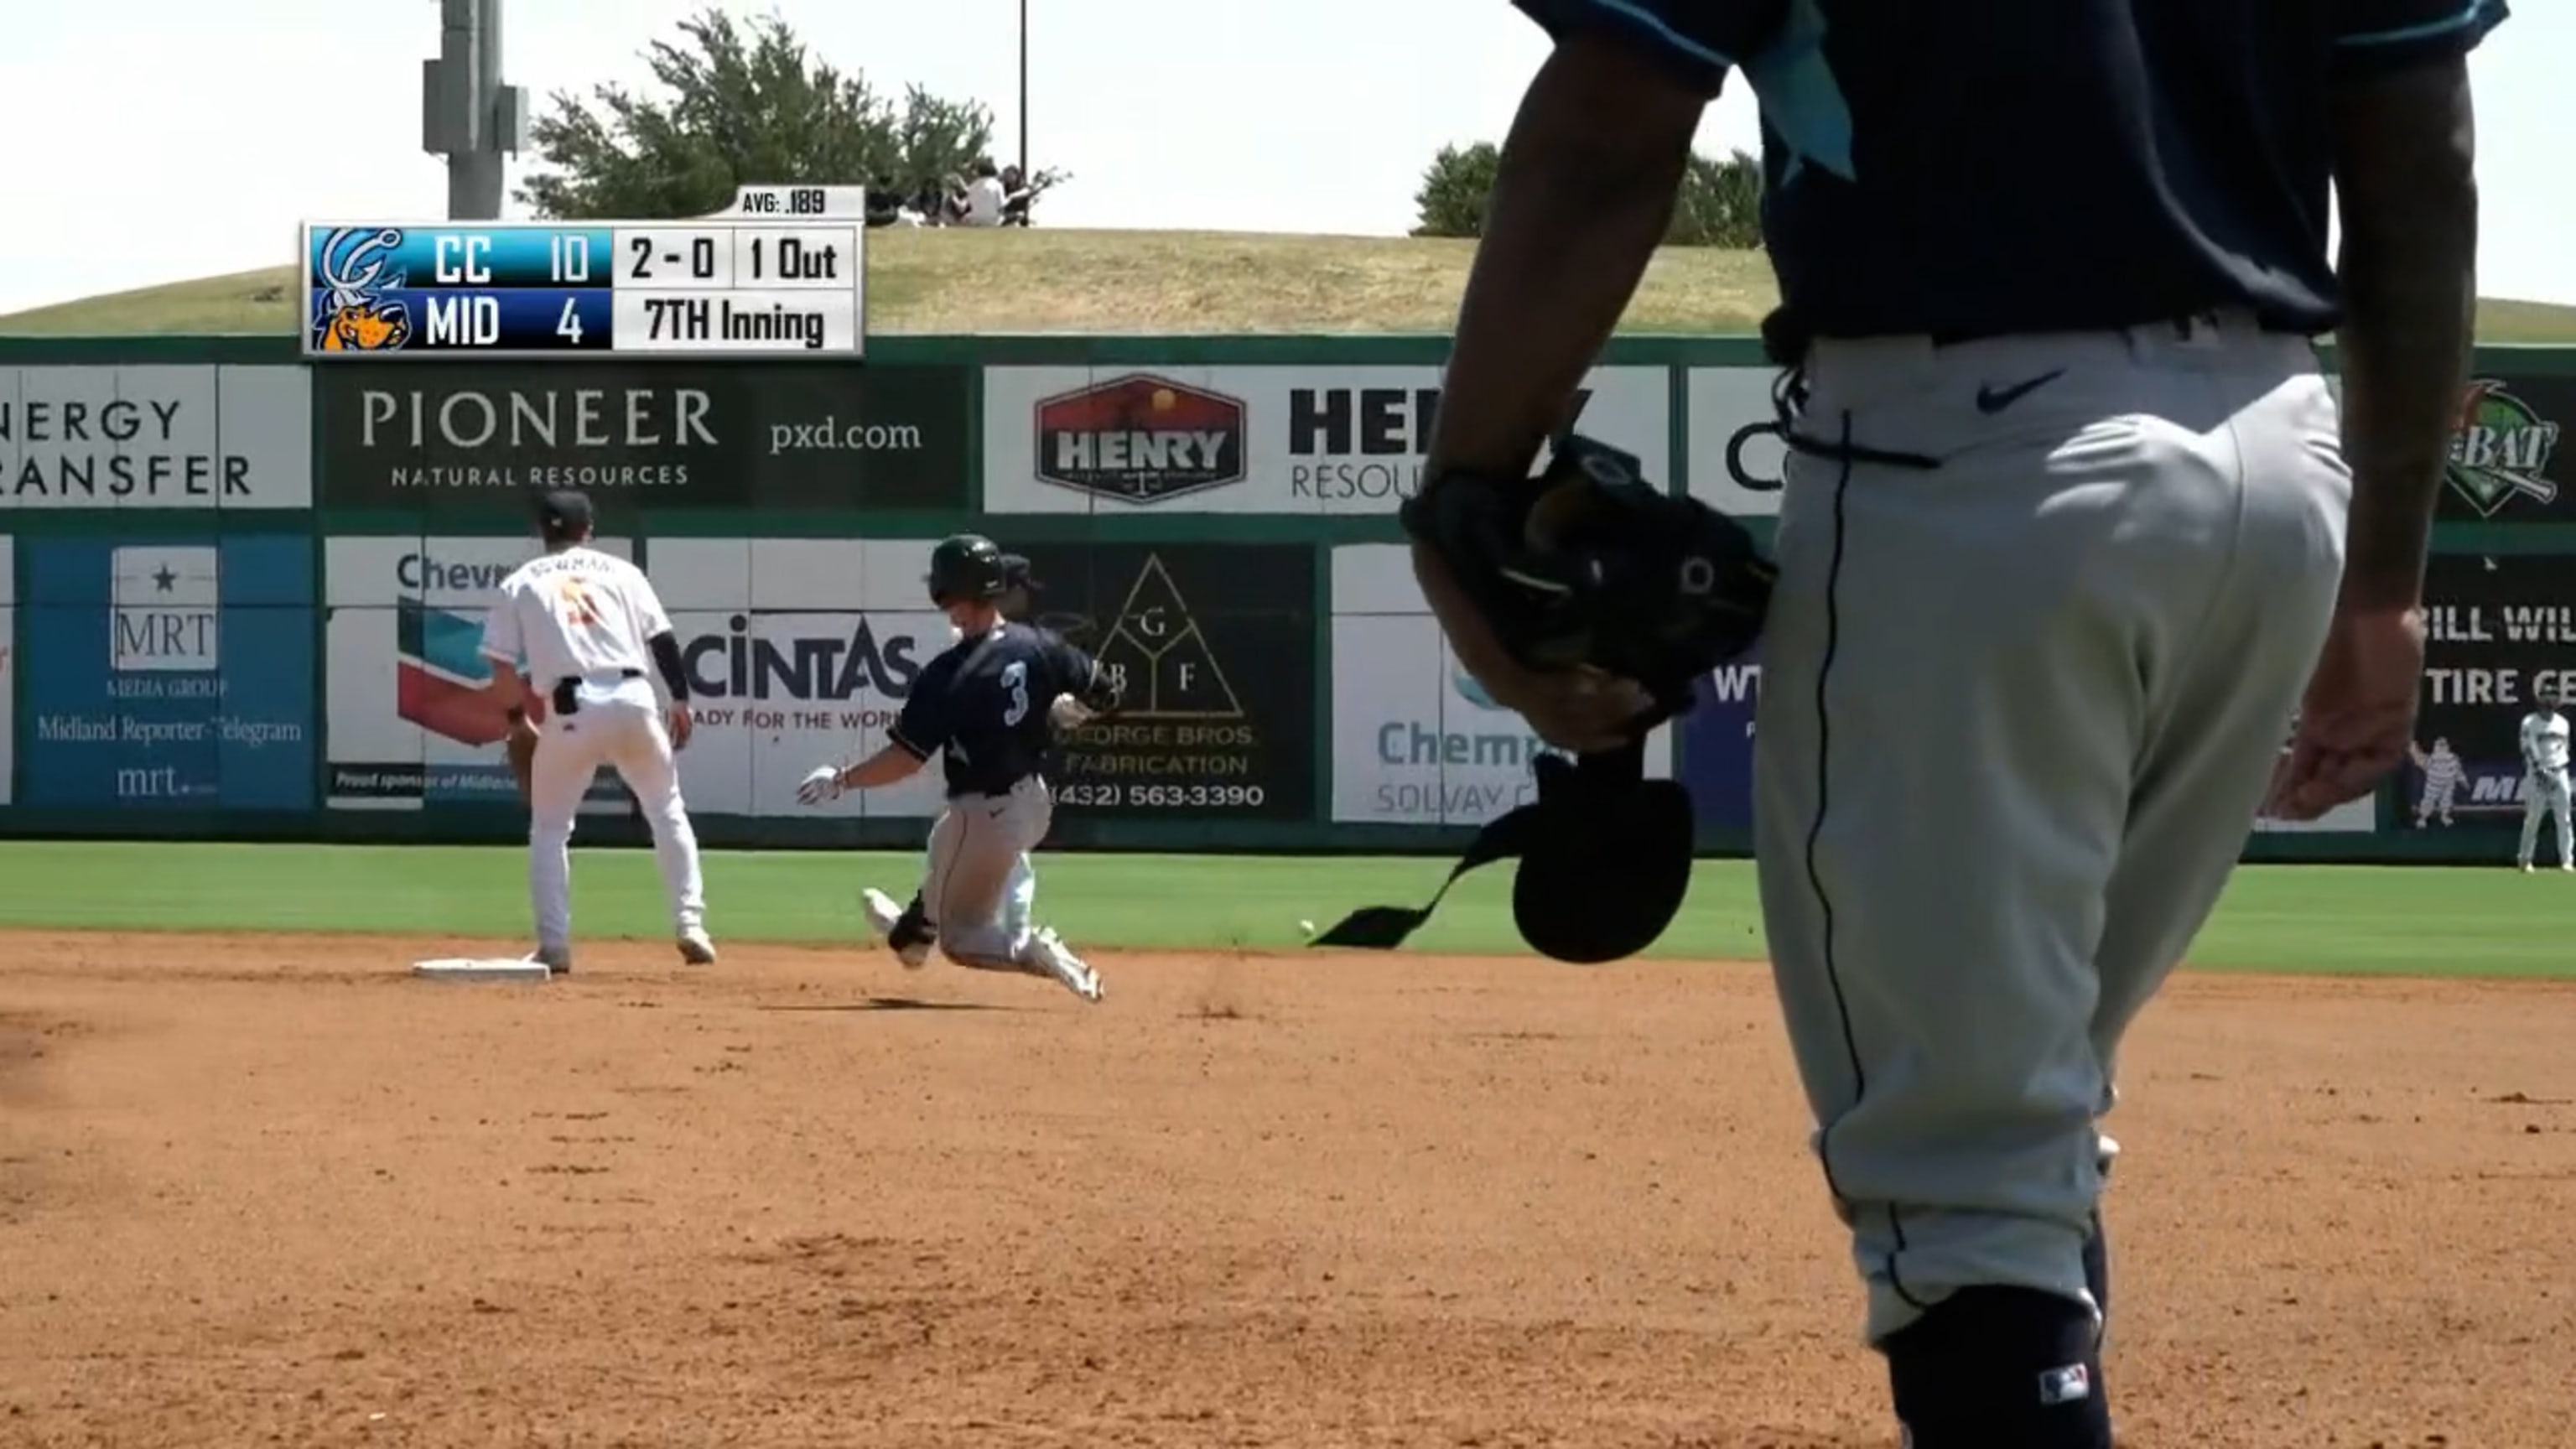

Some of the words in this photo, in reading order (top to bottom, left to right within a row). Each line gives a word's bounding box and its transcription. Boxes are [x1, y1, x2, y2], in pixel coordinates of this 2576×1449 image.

[361, 389, 719, 448] PIONEER
[770, 417, 922, 455] pxd.com
[1057, 429, 1228, 470] HENRY
[2464, 425, 2553, 468] BAT
[0, 454, 252, 496] ANSFER
[391, 465, 517, 486] NATURAL
[529, 465, 689, 486] RESOURCES
[397, 553, 520, 589] Chevr
[117, 613, 215, 657] MRT
[1140, 606, 1166, 637] G
[2421, 605, 2494, 641] ILL
[106, 679, 164, 698] MEDIA
[168, 679, 228, 698] GROUP
[1000, 659, 1029, 727] 3
[1178, 662, 1196, 691] F
[2425, 668, 2519, 704] TIRE
[38, 715, 117, 741] Midland
[742, 709, 784, 730] FOR
[796, 712, 832, 730] THE
[336, 771, 377, 788] Proud
[1066, 754, 1248, 776] FABRICATION
[1049, 785, 1121, 806] (432)
[1129, 785, 1265, 806] 563-3390
[1377, 783, 1504, 813] SOLVAY
